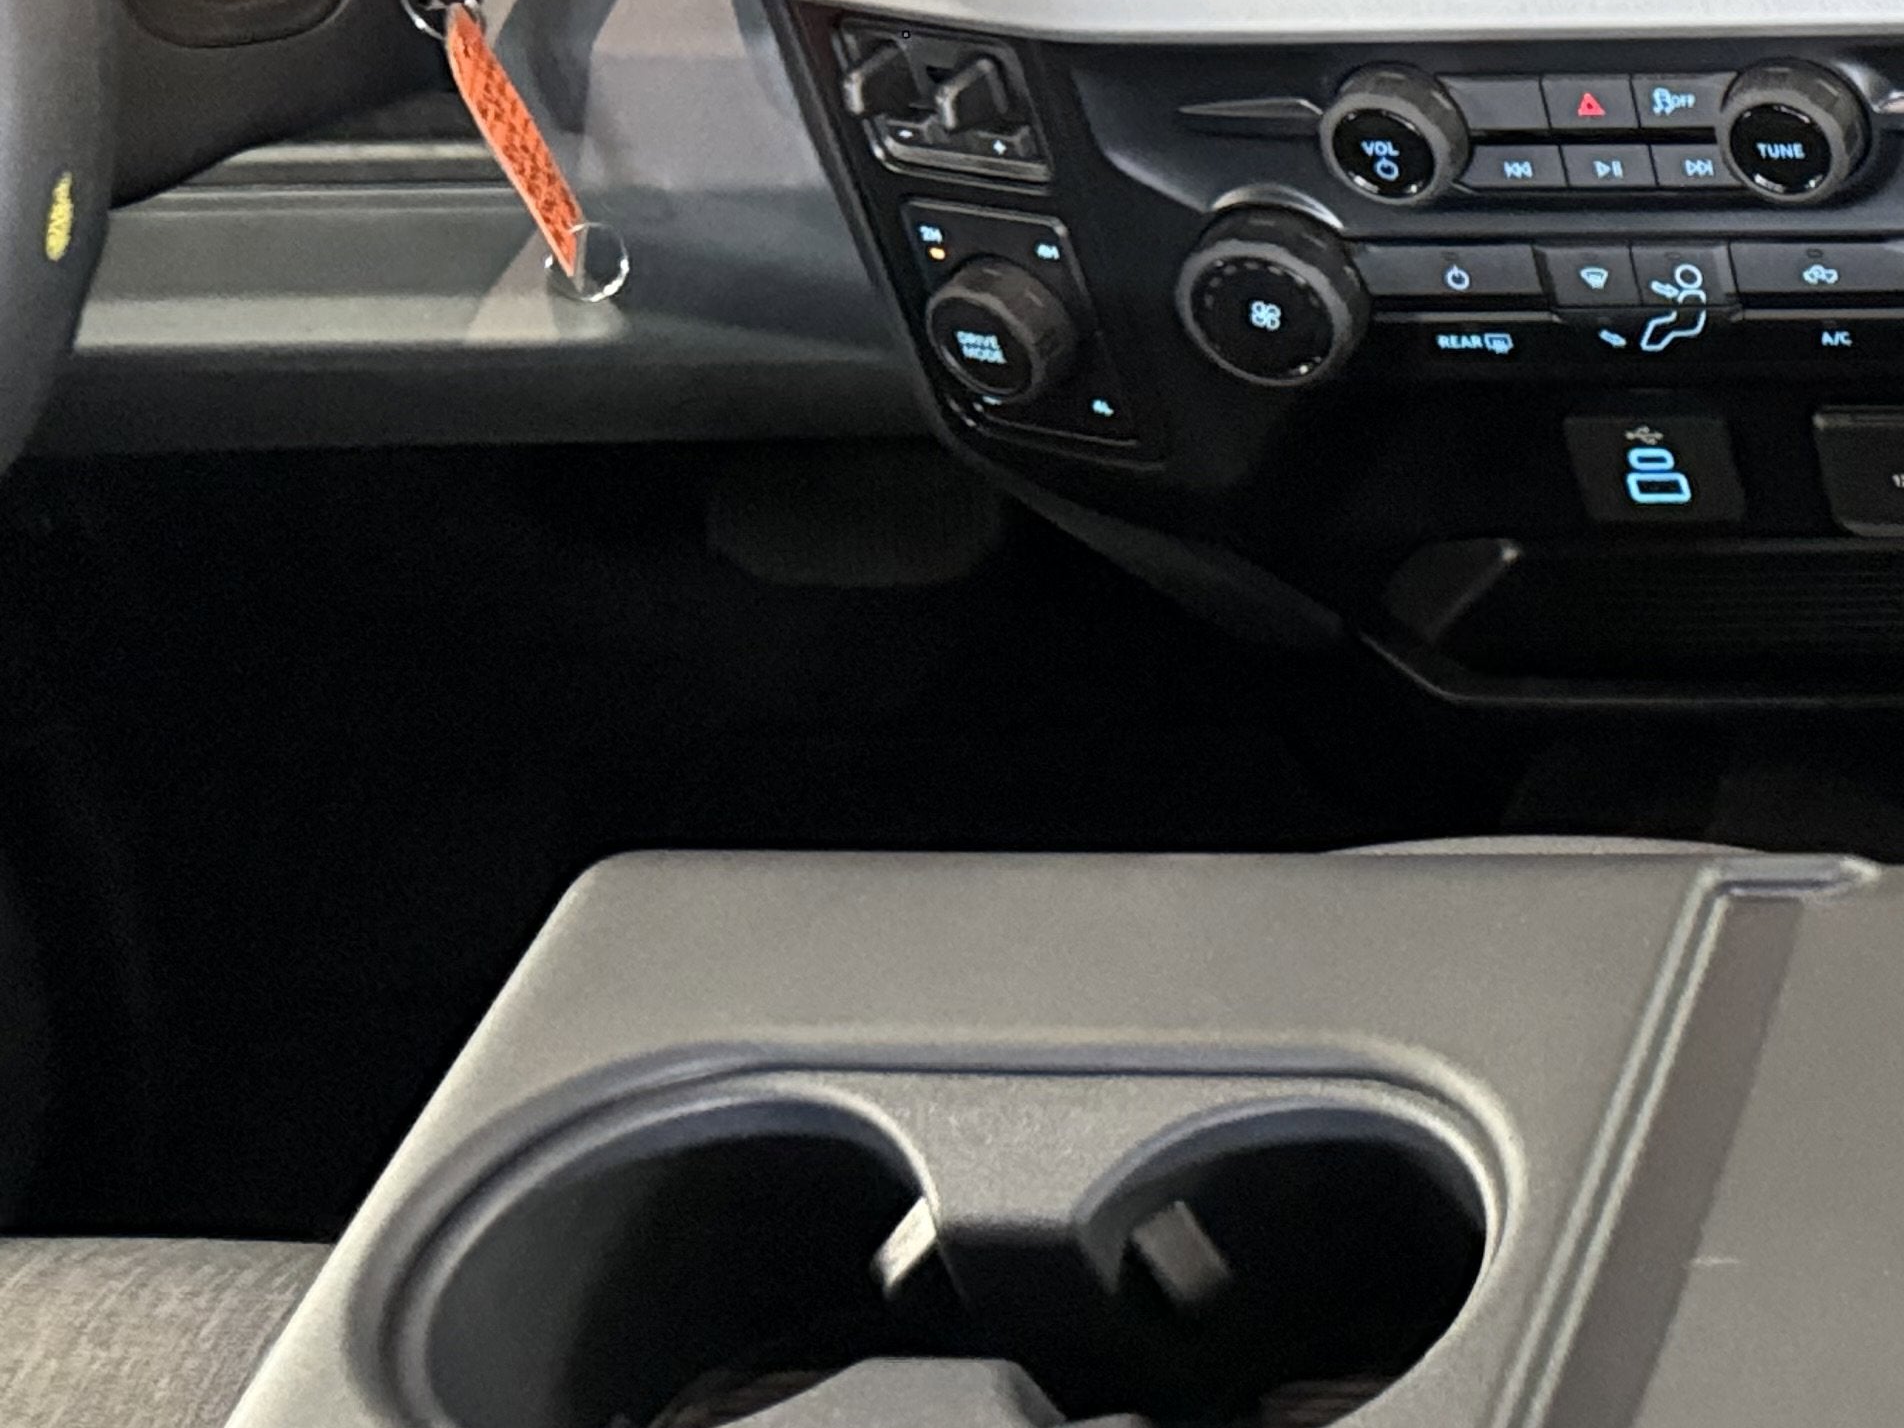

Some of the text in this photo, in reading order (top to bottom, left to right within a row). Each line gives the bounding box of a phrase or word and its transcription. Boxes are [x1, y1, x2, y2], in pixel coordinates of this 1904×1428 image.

[1361, 140, 1399, 156] VOL
[1756, 142, 1806, 159] TUNE
[1437, 334, 1483, 349] REAR
[1821, 330, 1852, 347] A/C
